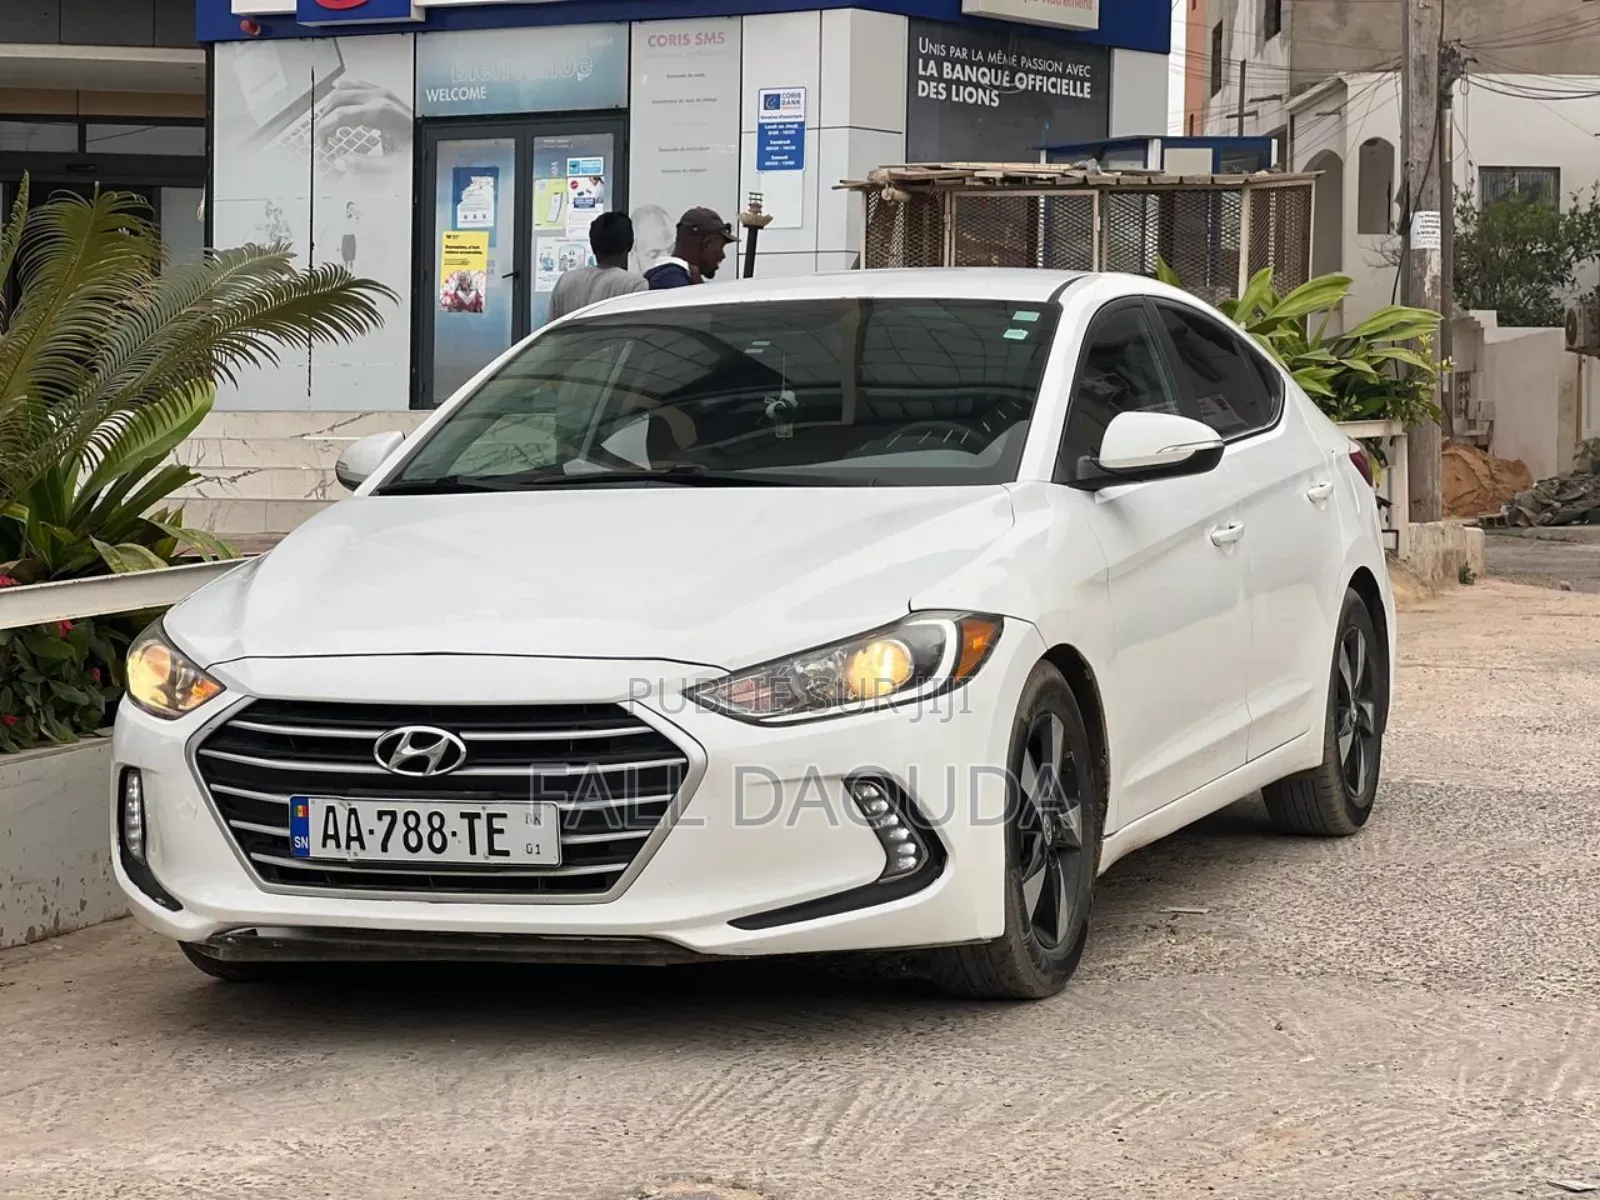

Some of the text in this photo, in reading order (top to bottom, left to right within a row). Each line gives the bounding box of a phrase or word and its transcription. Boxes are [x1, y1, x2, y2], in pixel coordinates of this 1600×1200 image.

[647, 31, 726, 48] CORIS SMS
[949, 45, 968, 60] PAR
[971, 49, 984, 63] LA
[1020, 56, 1062, 74] PASSION
[1065, 63, 1091, 77] AVEC
[918, 58, 1091, 98] LA BANQUE OFFICIELLE
[425, 86, 487, 102] WELCOME
[918, 80, 1000, 107] DES LIONS
[294, 836, 309, 850] SN
